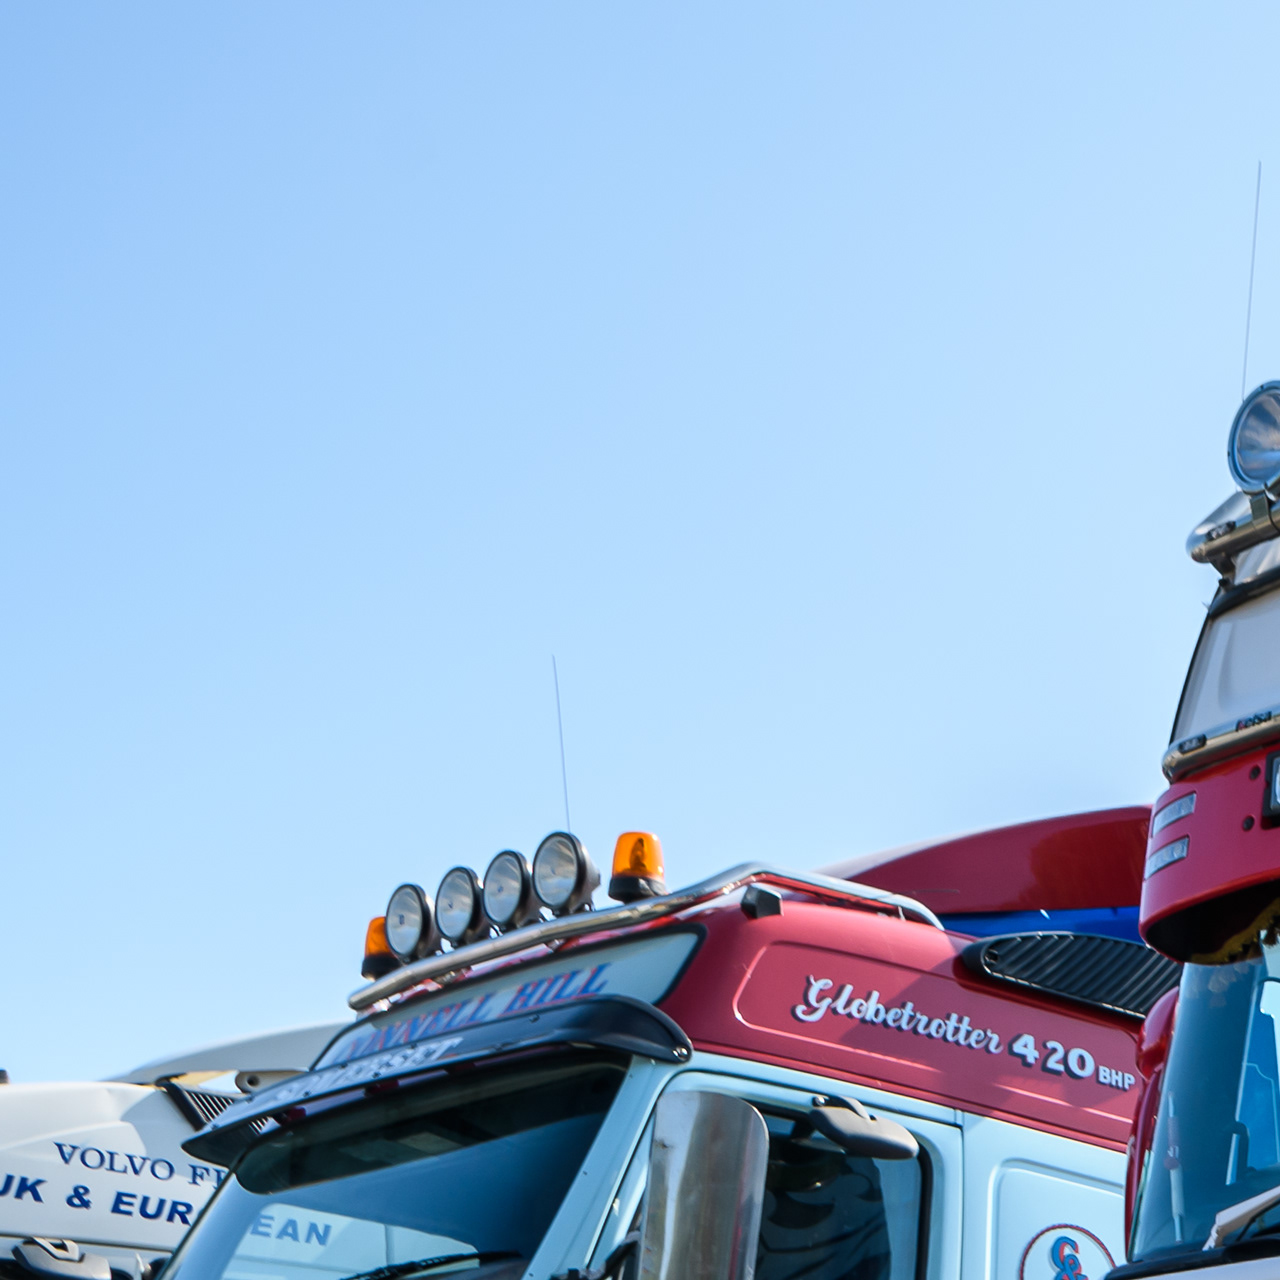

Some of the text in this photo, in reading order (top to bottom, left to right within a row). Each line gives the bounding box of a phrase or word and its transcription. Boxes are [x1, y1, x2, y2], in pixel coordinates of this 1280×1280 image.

[792, 974, 1137, 1091] Globetrotter 420 BHP
[54, 1142, 174, 1180] VOLVO
[65, 1185, 92, 1210] &
